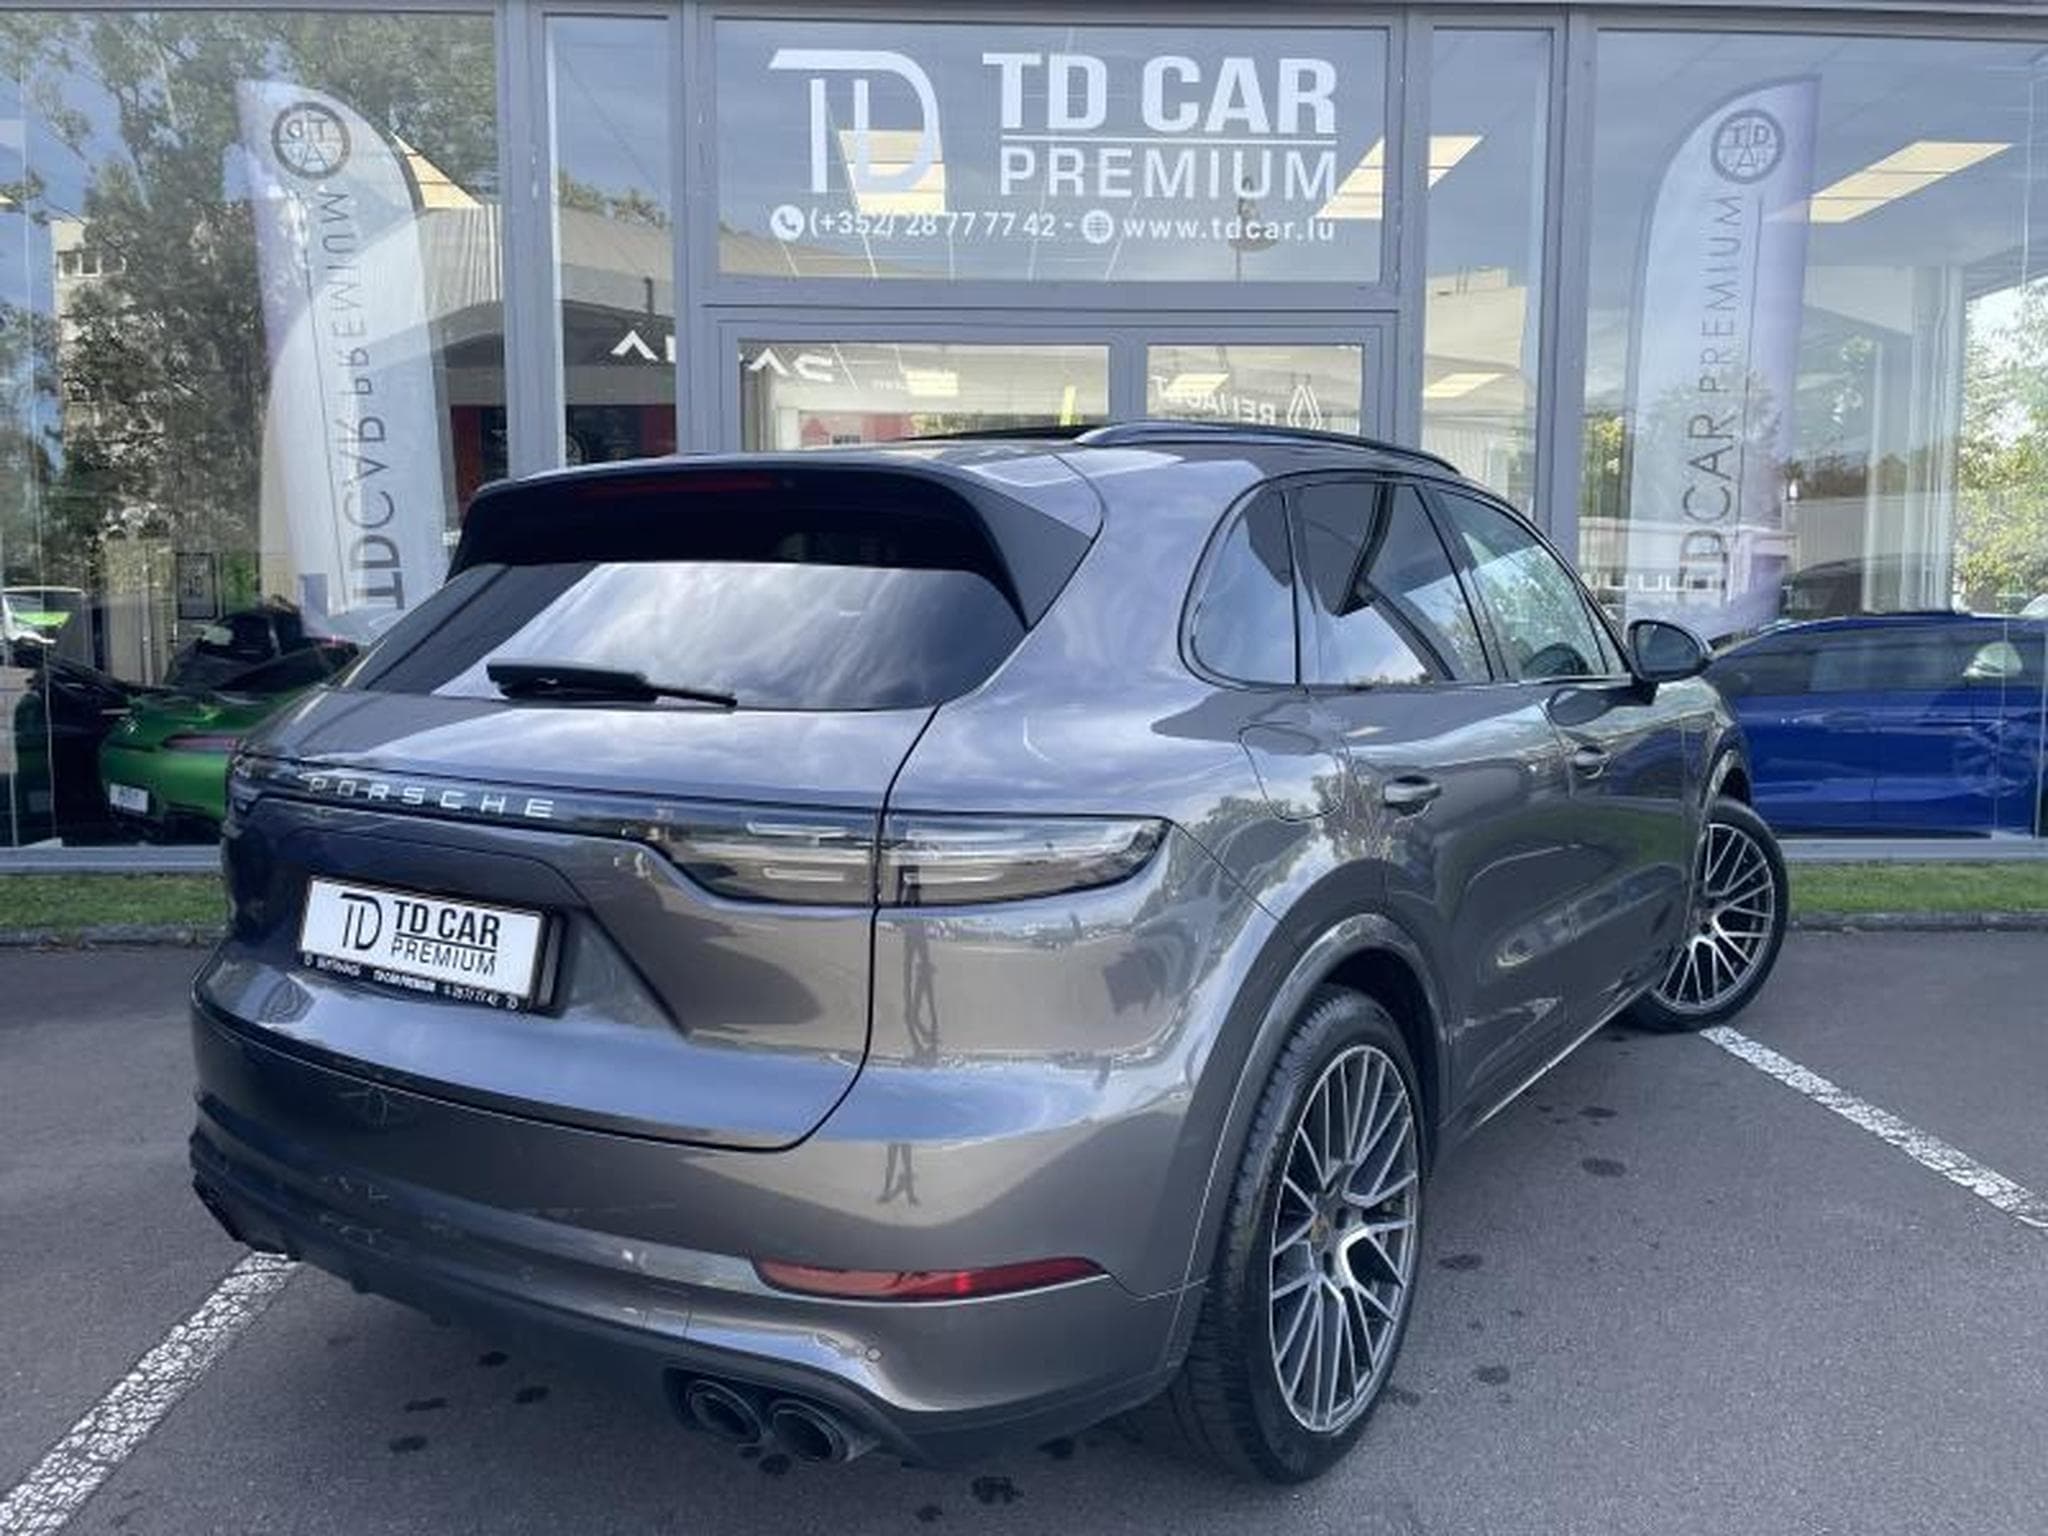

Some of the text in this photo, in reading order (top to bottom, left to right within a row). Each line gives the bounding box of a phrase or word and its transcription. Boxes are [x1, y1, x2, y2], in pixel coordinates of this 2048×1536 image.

[982, 52, 1337, 134] TD CAR
[1000, 147, 1336, 200] PREMIUM
[904, 212, 938, 237] 28
[944, 211, 976, 237] 77
[982, 211, 1016, 237] 77
[1022, 211, 1057, 238] 42
[1122, 215, 1336, 241] www.tdcar.lu
[1700, 195, 1743, 394] PREMIUM
[308, 777, 555, 818] PORSCHE
[393, 900, 501, 947] TD CAR
[390, 936, 497, 977] PREMIUM
